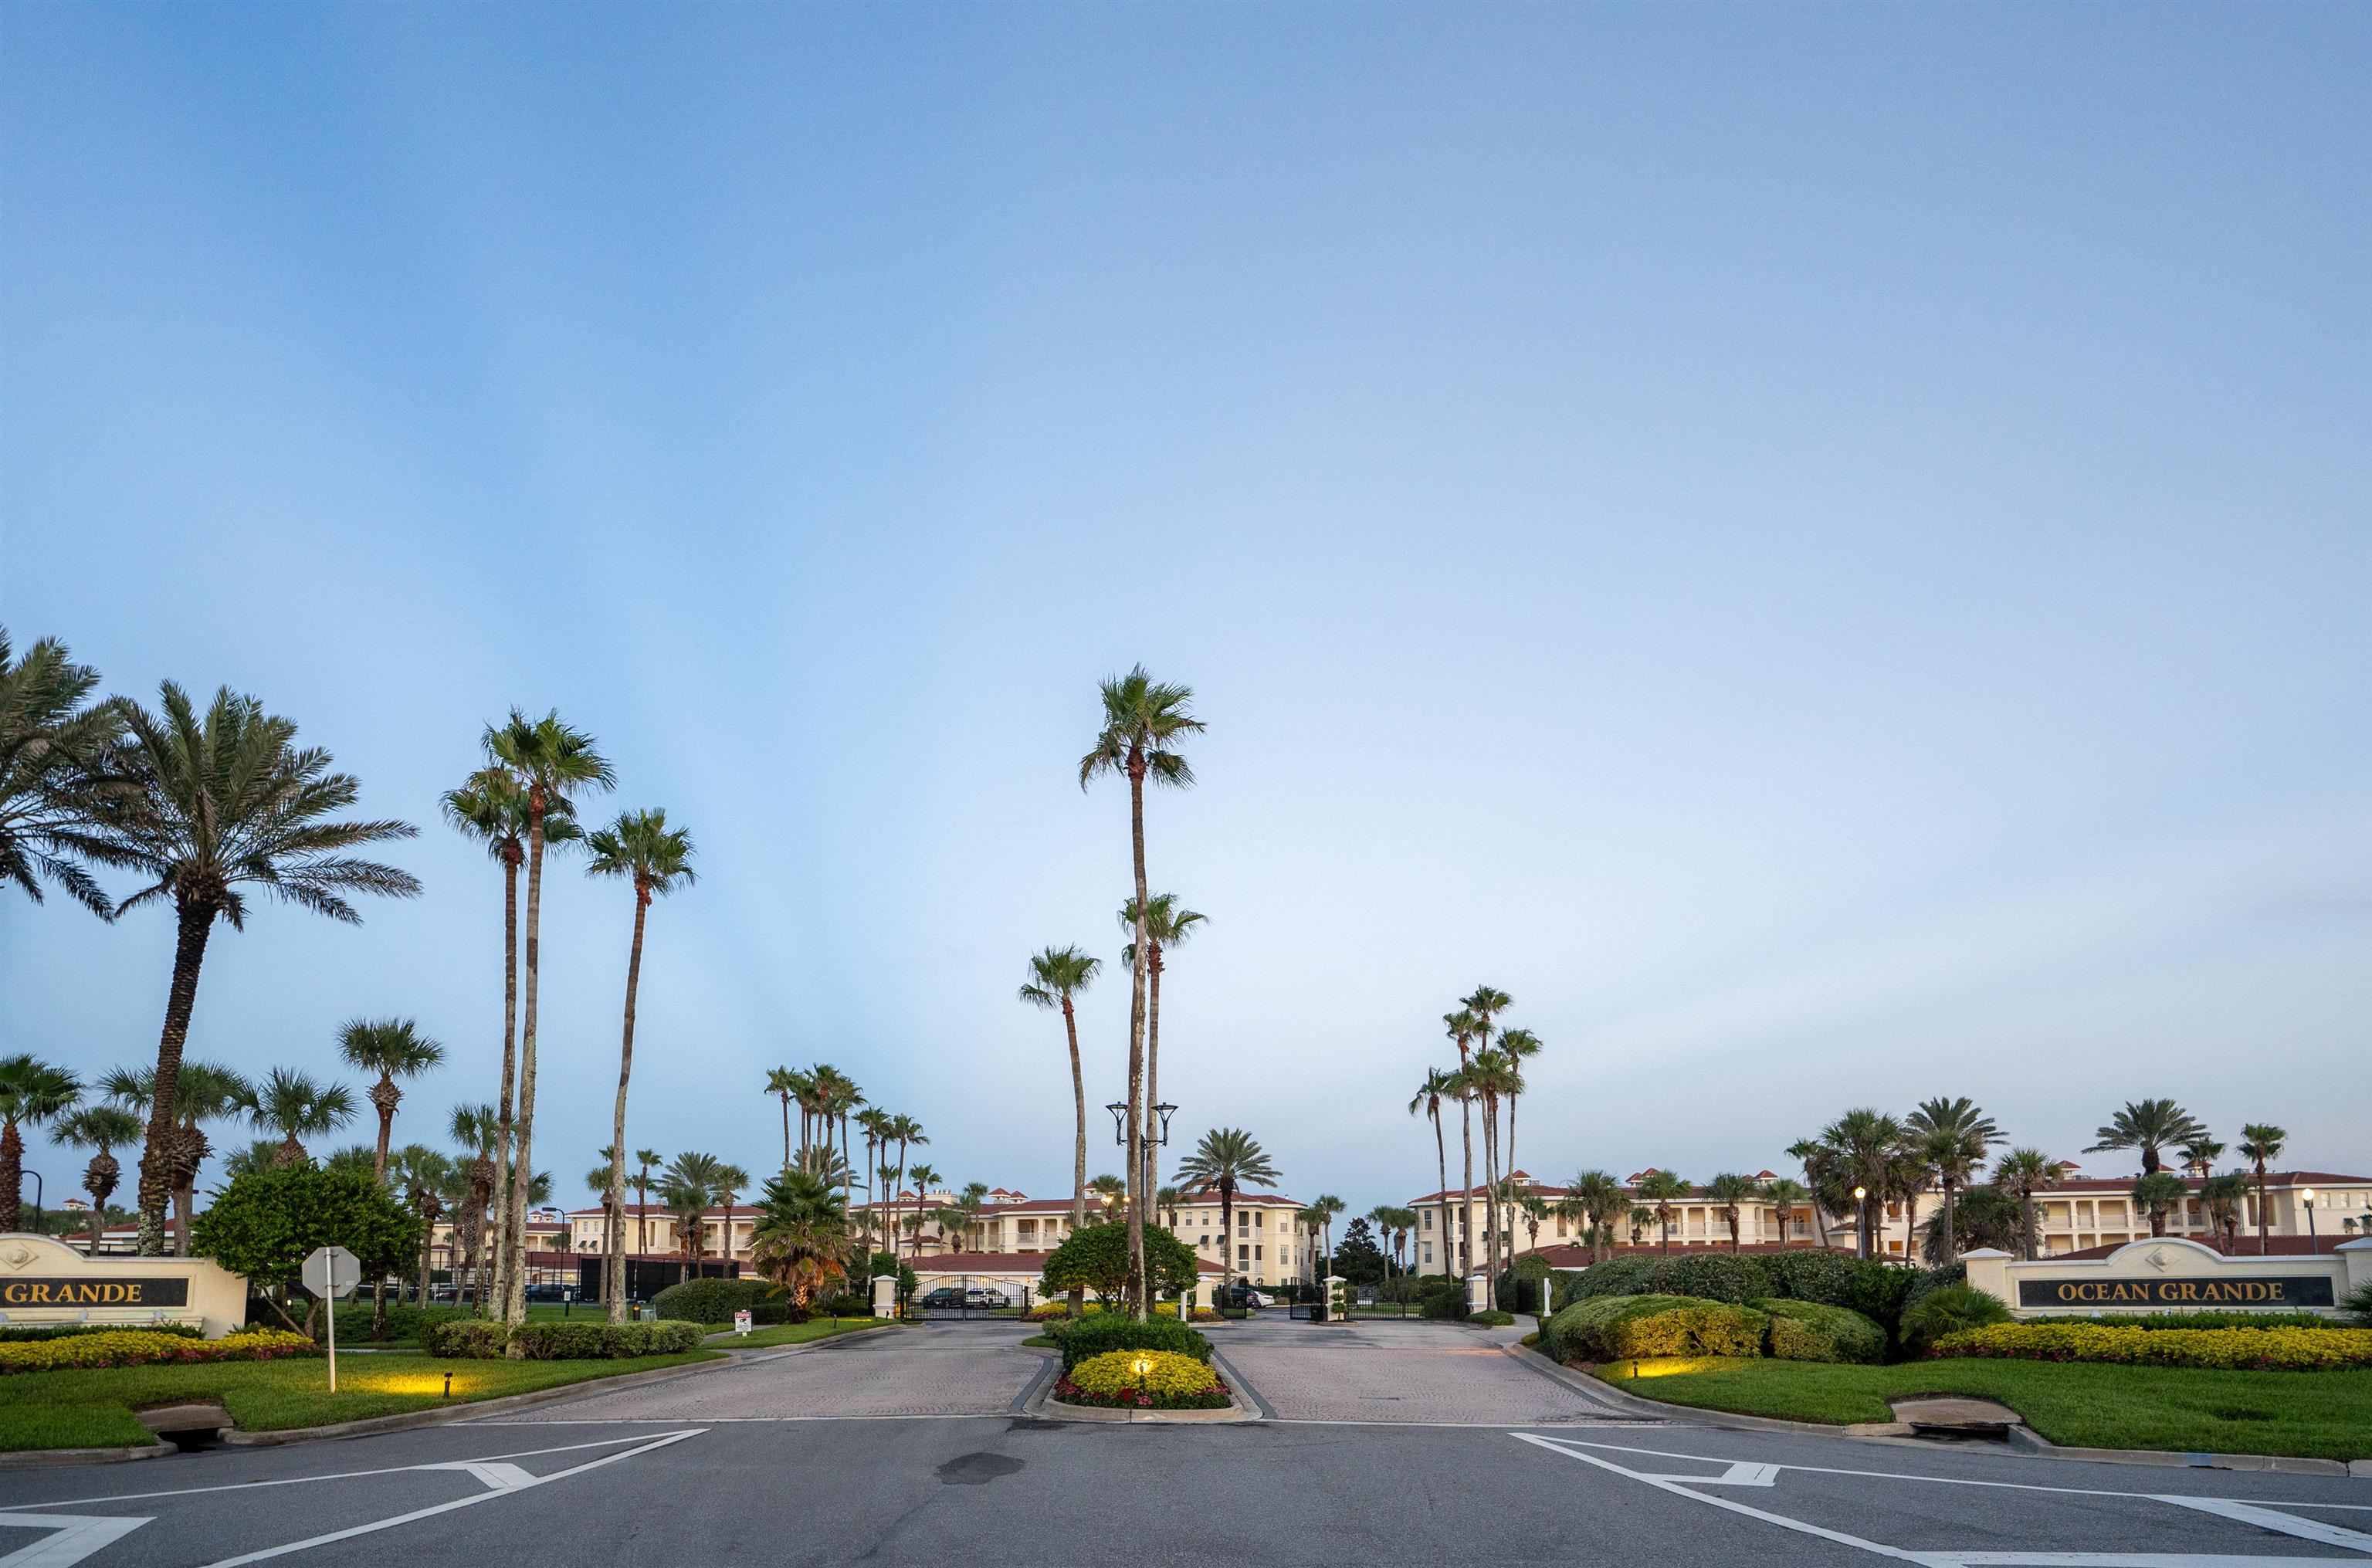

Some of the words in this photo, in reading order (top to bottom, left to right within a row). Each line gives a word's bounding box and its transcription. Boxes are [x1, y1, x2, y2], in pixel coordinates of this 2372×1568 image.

[5, 1283, 142, 1302] GRANDE
[2058, 1283, 2149, 1301] OCEAN
[2158, 1282, 2285, 1301] GRANDE
